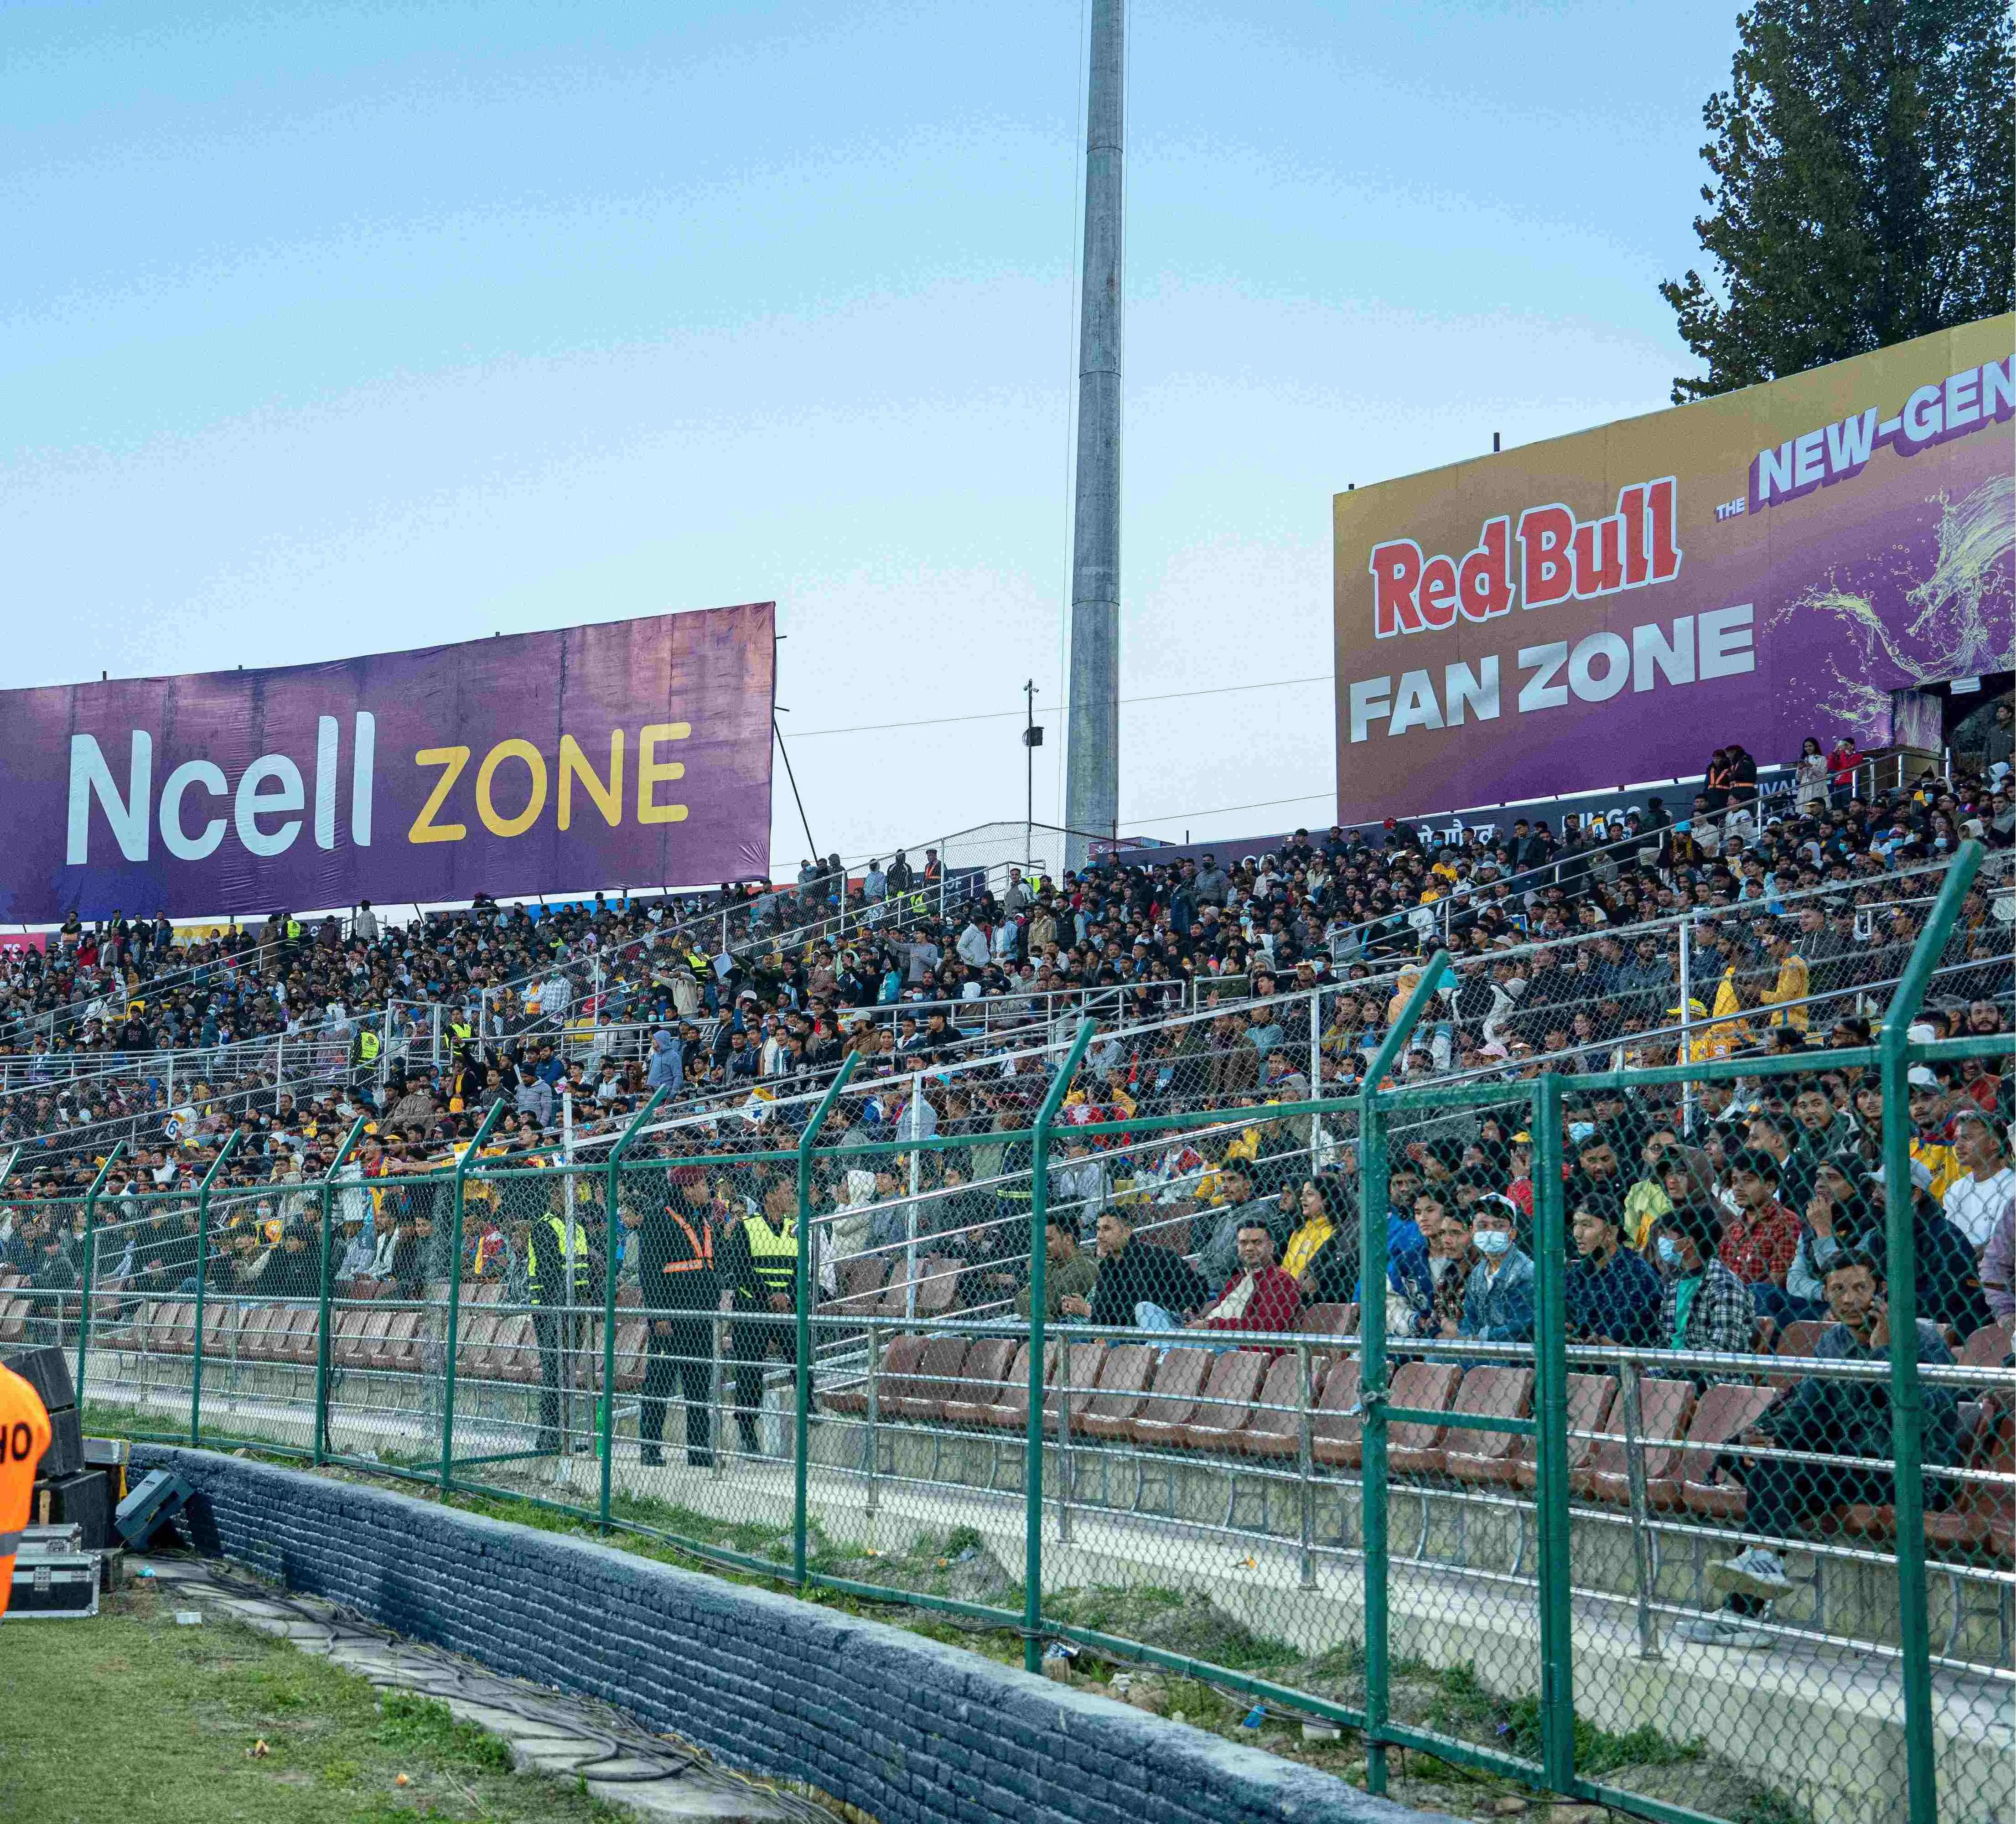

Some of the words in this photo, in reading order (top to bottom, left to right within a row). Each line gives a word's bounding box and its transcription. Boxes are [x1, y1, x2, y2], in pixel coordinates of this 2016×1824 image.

[1715, 497, 1745, 522] THE
[1753, 353, 2016, 508] NEW-GEN
[1369, 538, 1515, 638] Red
[1516, 476, 1682, 609] Bull
[1350, 655, 1500, 743] FAN
[1518, 603, 1755, 713] ZONE
[66, 711, 375, 865] Ncell
[408, 721, 691, 844] ZONE
[168, 1120, 179, 1135] 6
